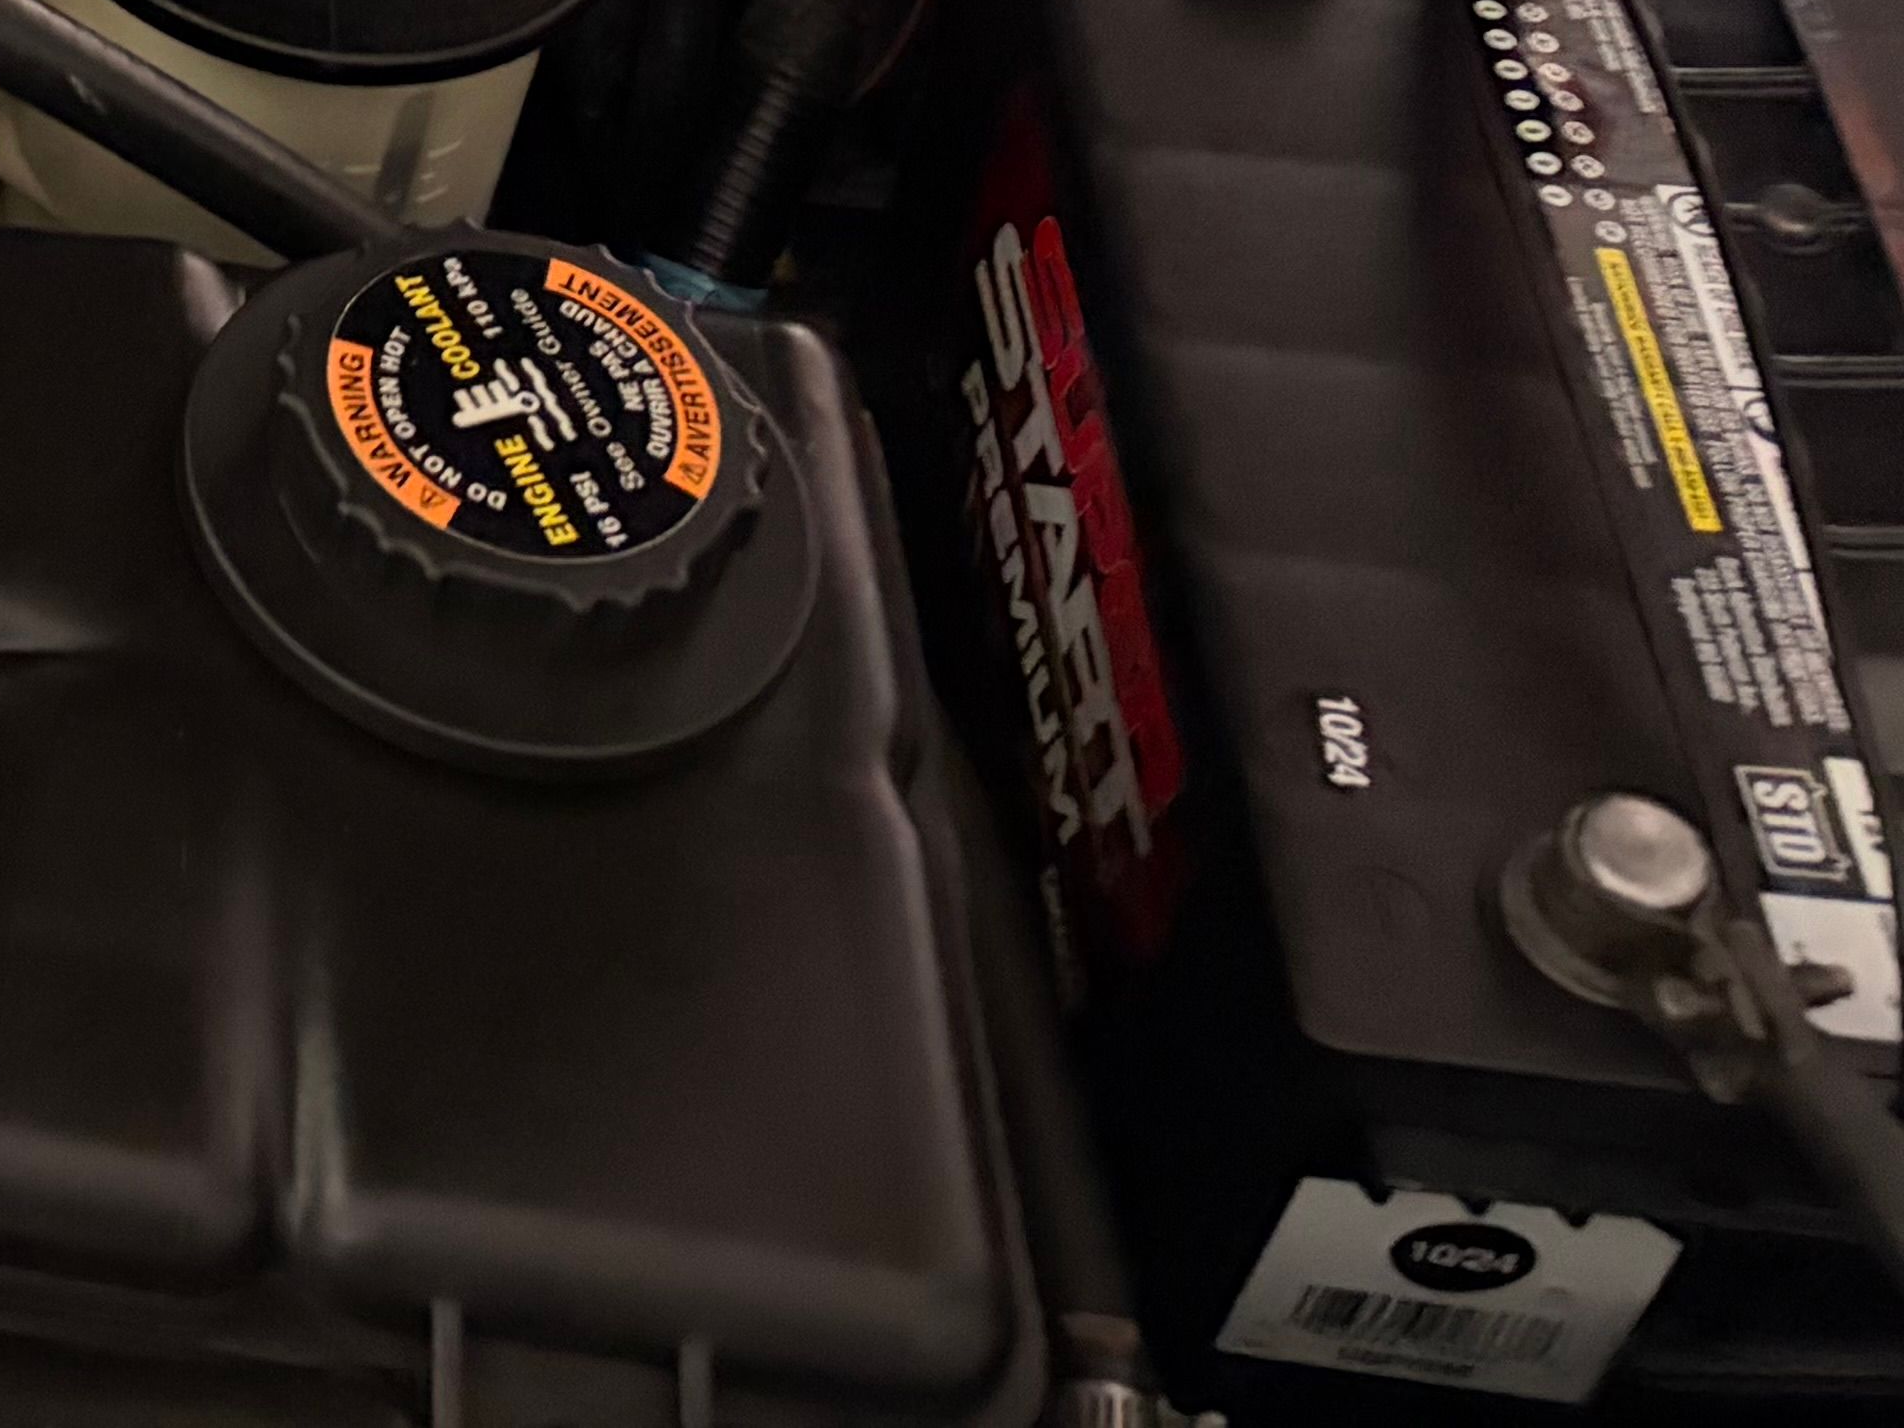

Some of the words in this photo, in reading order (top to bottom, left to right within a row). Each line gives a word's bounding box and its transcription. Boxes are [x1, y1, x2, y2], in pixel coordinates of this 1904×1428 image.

[442, 255, 477, 299] kPa
[379, 325, 412, 371] HOT
[394, 273, 482, 380] COOLANT
[467, 300, 506, 340] 110
[510, 287, 562, 356] Guide
[559, 298, 635, 360] CHAUD
[556, 271, 712, 462] AVERTISSEMENT
[589, 340, 632, 378] PAS
[338, 351, 412, 490] WARNING
[377, 374, 417, 440] OPEN
[554, 359, 612, 438] Owner
[615, 379, 645, 412] NE
[646, 378, 673, 459] OUVRIR
[408, 443, 463, 489] NOT
[465, 482, 508, 512] DO
[494, 434, 581, 547] ENGINE
[606, 442, 645, 493] See
[597, 516, 630, 549] 16
[973, 220, 1152, 859] START
[961, 358, 1082, 846] PREMIUM
[1313, 693, 1372, 791] 10/24
